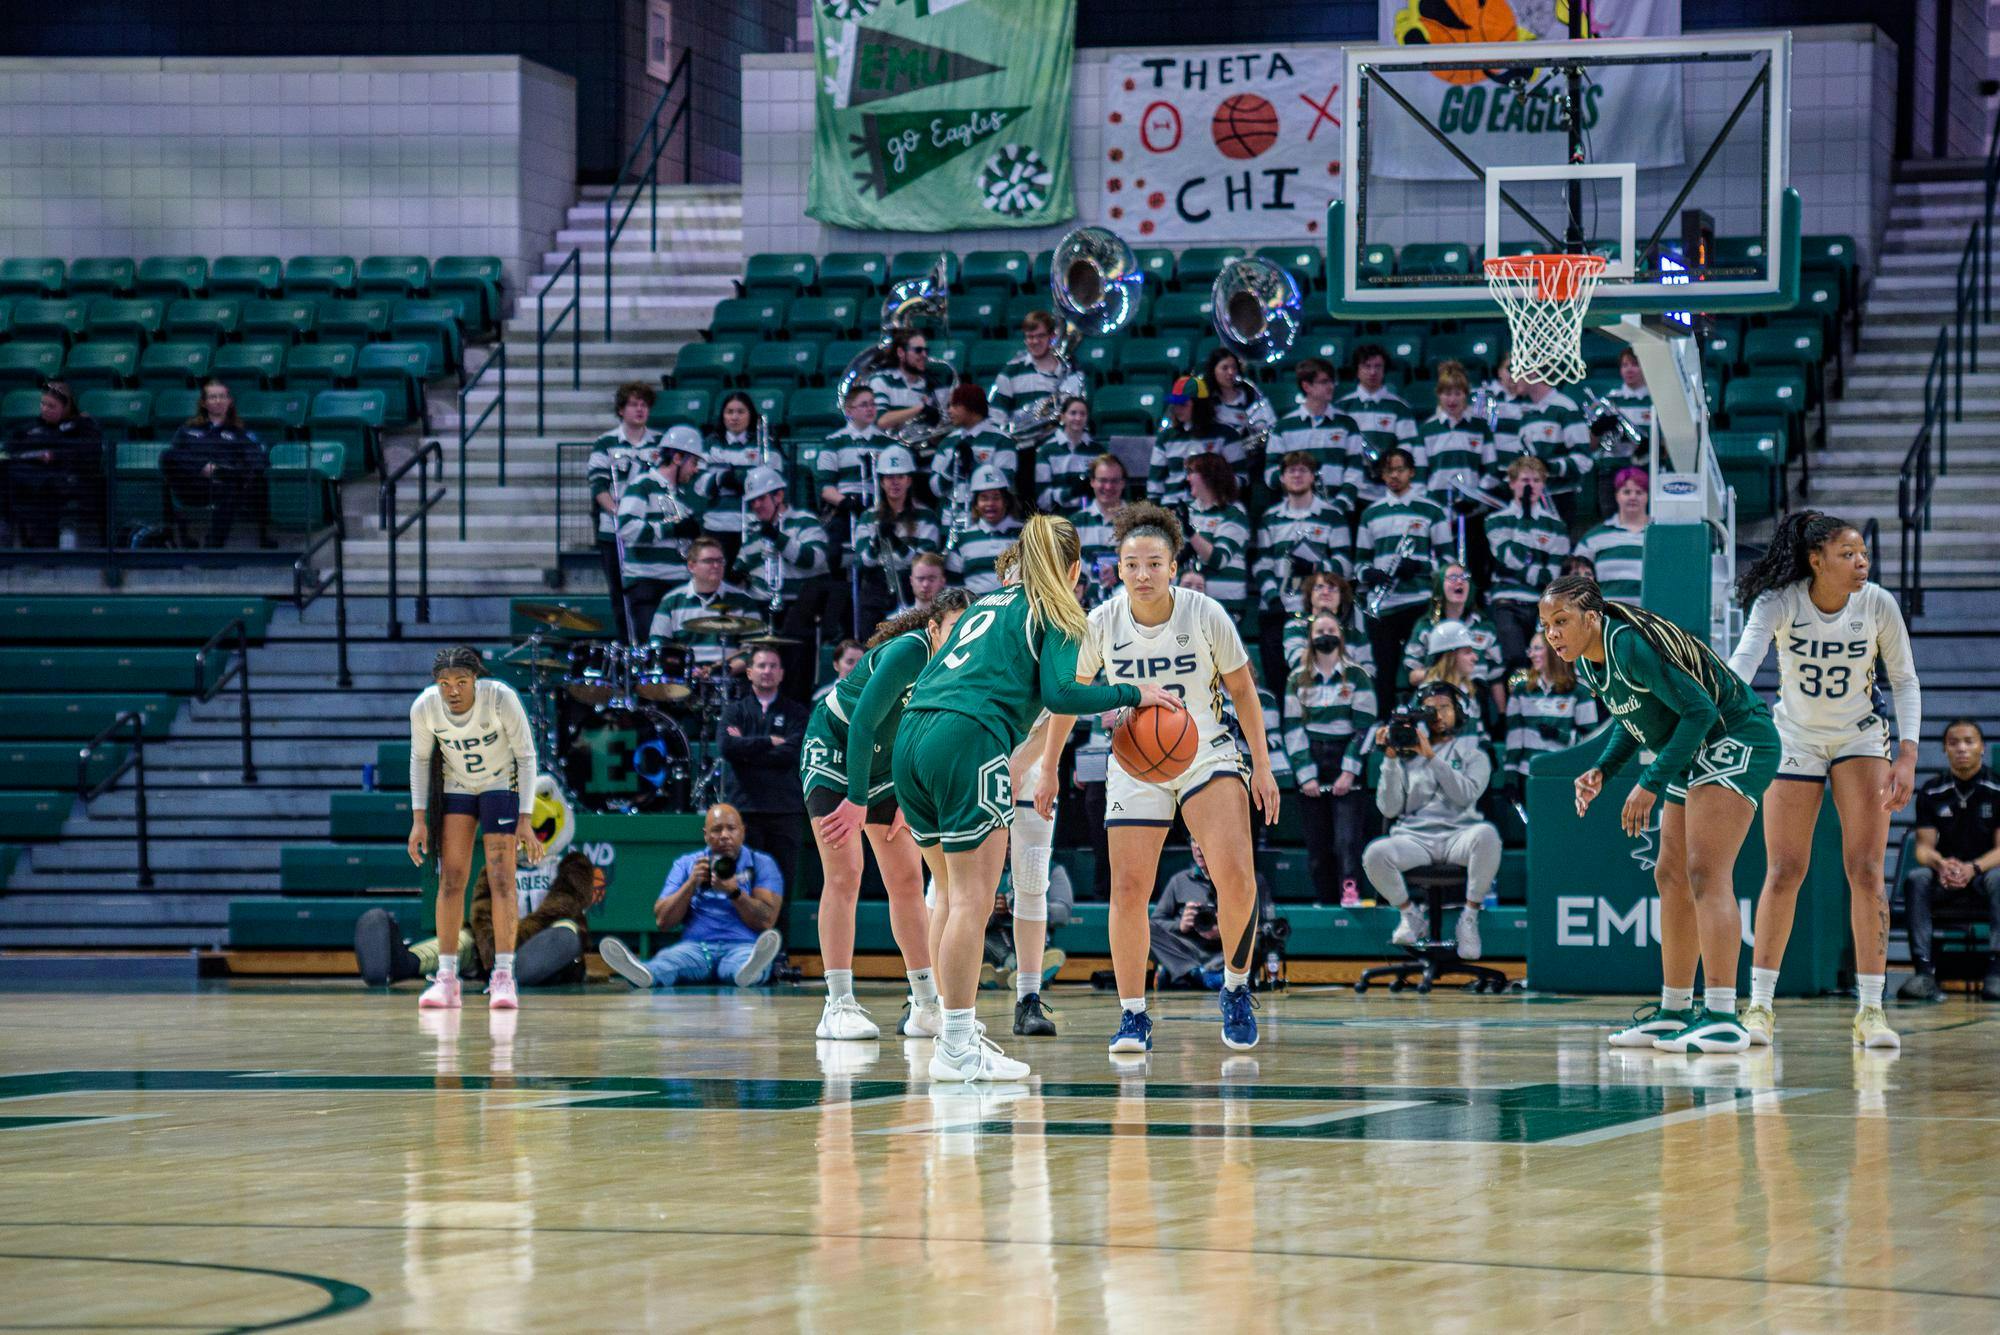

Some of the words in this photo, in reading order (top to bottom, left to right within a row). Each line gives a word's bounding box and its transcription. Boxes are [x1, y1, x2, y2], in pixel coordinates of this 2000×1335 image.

[859, 43, 949, 91] EMU
[1141, 52, 1296, 91] THETA
[1439, 85, 1487, 134] GO
[1487, 84, 1604, 134] EAGLS
[887, 130, 921, 171] go
[930, 111, 1008, 146] Eagles
[1174, 167, 1300, 224] CHI
[941, 610, 996, 670] 2
[1789, 634, 1868, 660] ZIPS
[1112, 653, 1197, 679] ZIPS
[1798, 663, 1852, 700] 33
[463, 753, 487, 774] 2
[1710, 742, 1738, 766] E
[1784, 757, 1800, 768] A
[994, 772, 1011, 806] E
[1111, 801, 1125, 812] A
[1556, 896, 1663, 948] EM
